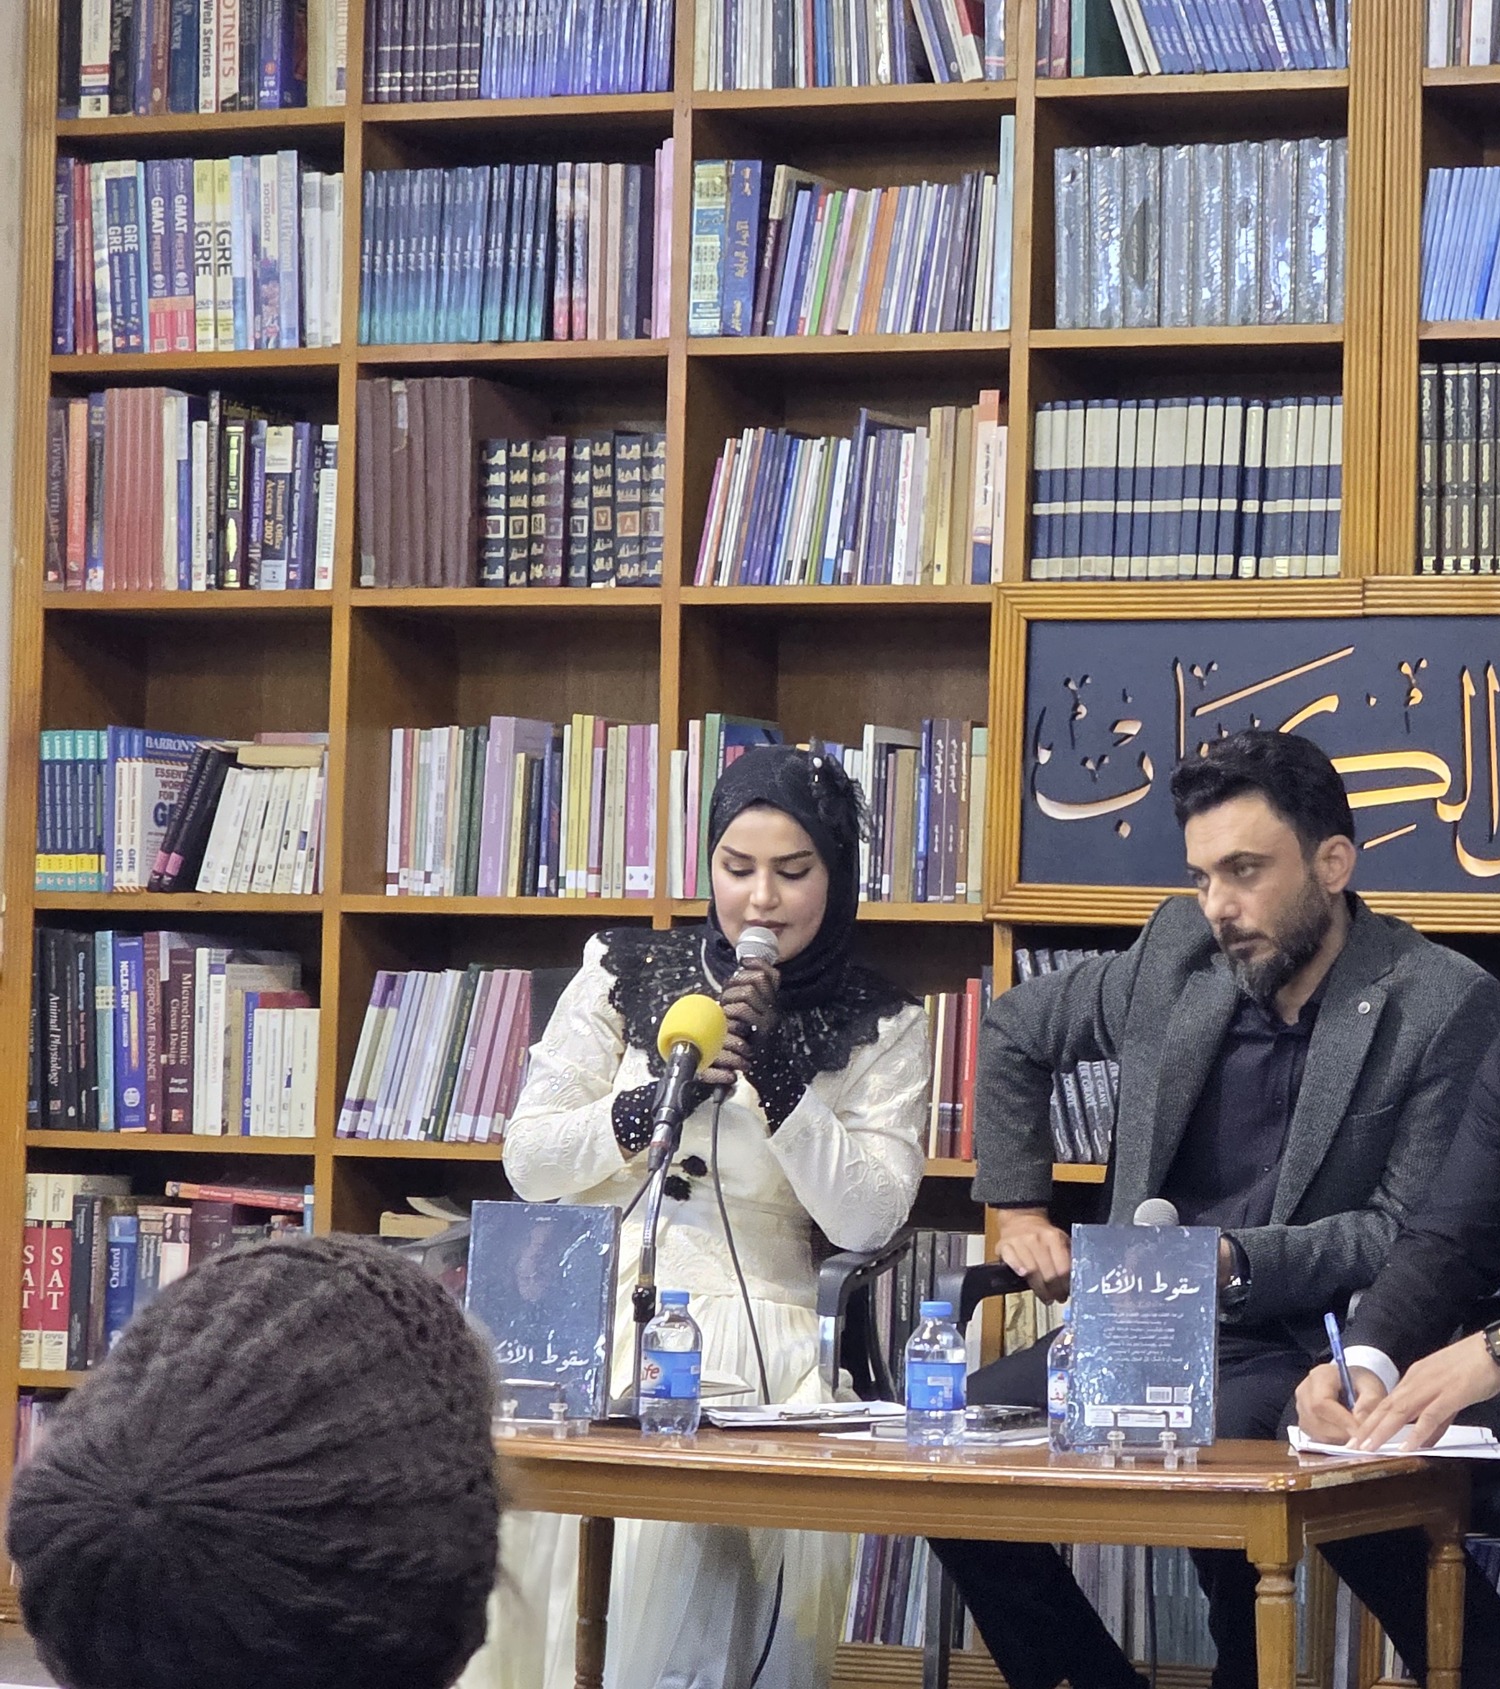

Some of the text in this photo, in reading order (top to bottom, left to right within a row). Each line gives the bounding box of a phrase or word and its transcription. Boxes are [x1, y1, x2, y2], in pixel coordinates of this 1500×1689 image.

[202, 0, 213, 78] Web Services
[151, 196, 164, 235] GMAT
[174, 194, 187, 233] GMAT
[263, 183, 271, 242] SOCIOLOGY
[108, 226, 122, 254] GRE
[123, 224, 138, 252] GRE
[195, 230, 212, 277] GRE
[216, 229, 232, 277] GRE
[49, 481, 60, 513] WITH
[265, 479, 274, 546] Access 2007
[275, 479, 285, 549] Microsoft Office
[154, 768, 190, 780] ESSENT
[48, 993, 61, 1087] Animal Physiology
[146, 969, 156, 1081] CORPORATE FINANCE
[168, 998, 180, 1066] Circuit Design
[180, 973, 192, 1066] Microelectronic
[47, 1245, 64, 1310] SAT
[109, 1248, 121, 1288] Oxford
[1086, 1265, 1200, 1301] سقوط الأفكار
[541, 1342, 589, 1372] سقوط
